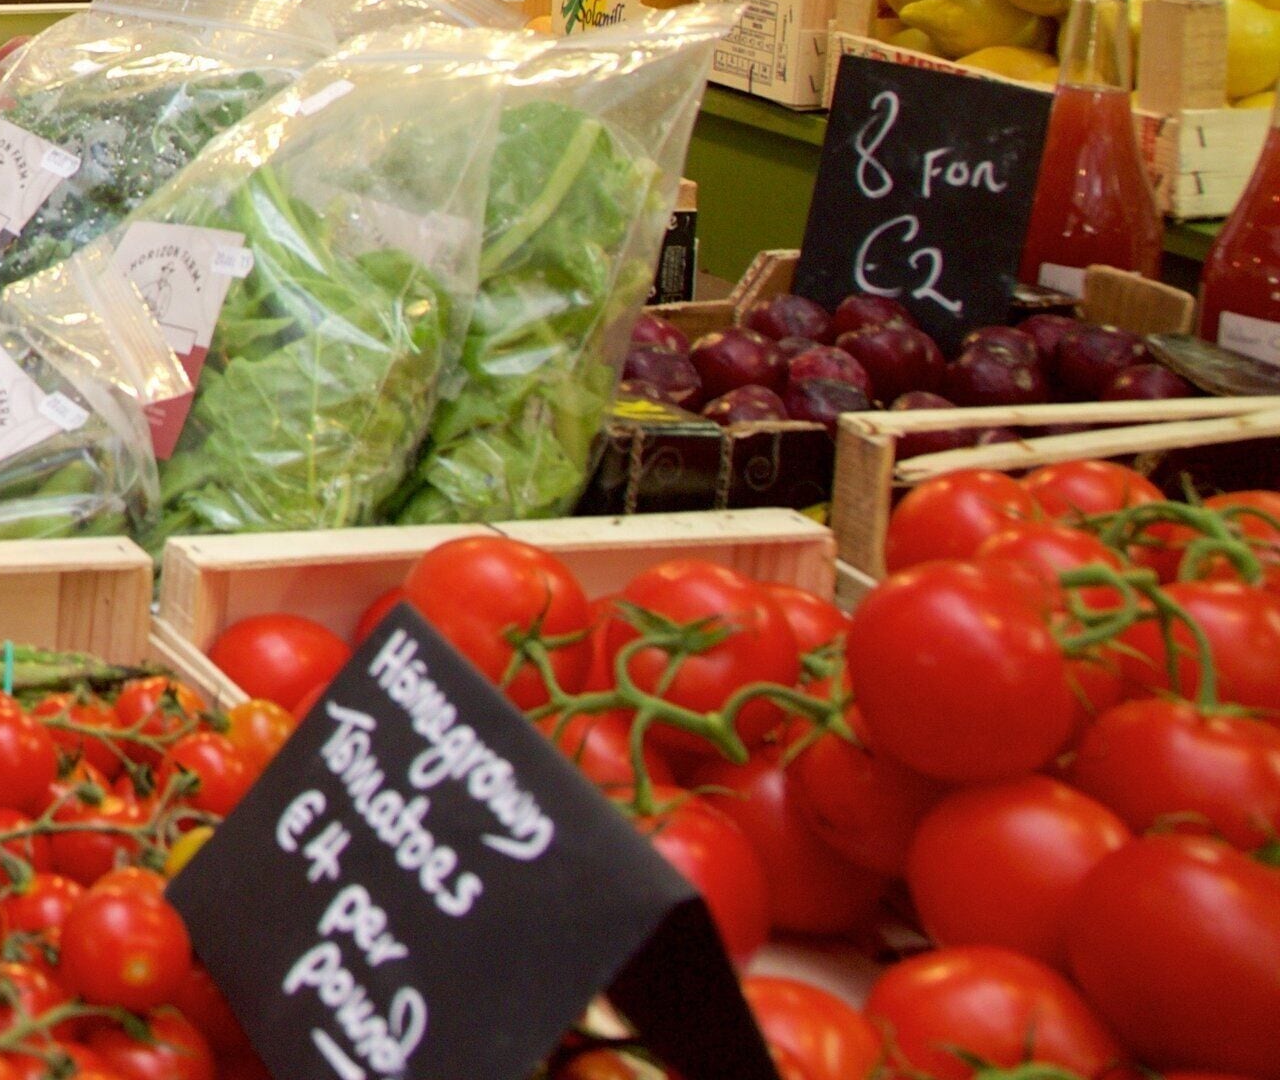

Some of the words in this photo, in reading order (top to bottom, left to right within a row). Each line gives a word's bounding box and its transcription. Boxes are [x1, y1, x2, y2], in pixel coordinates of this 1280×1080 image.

[855, 90, 900, 199] 8
[854, 214, 963, 313] €2
[276, 790, 351, 884] €4
[326, 700, 484, 918] Tomatoes
